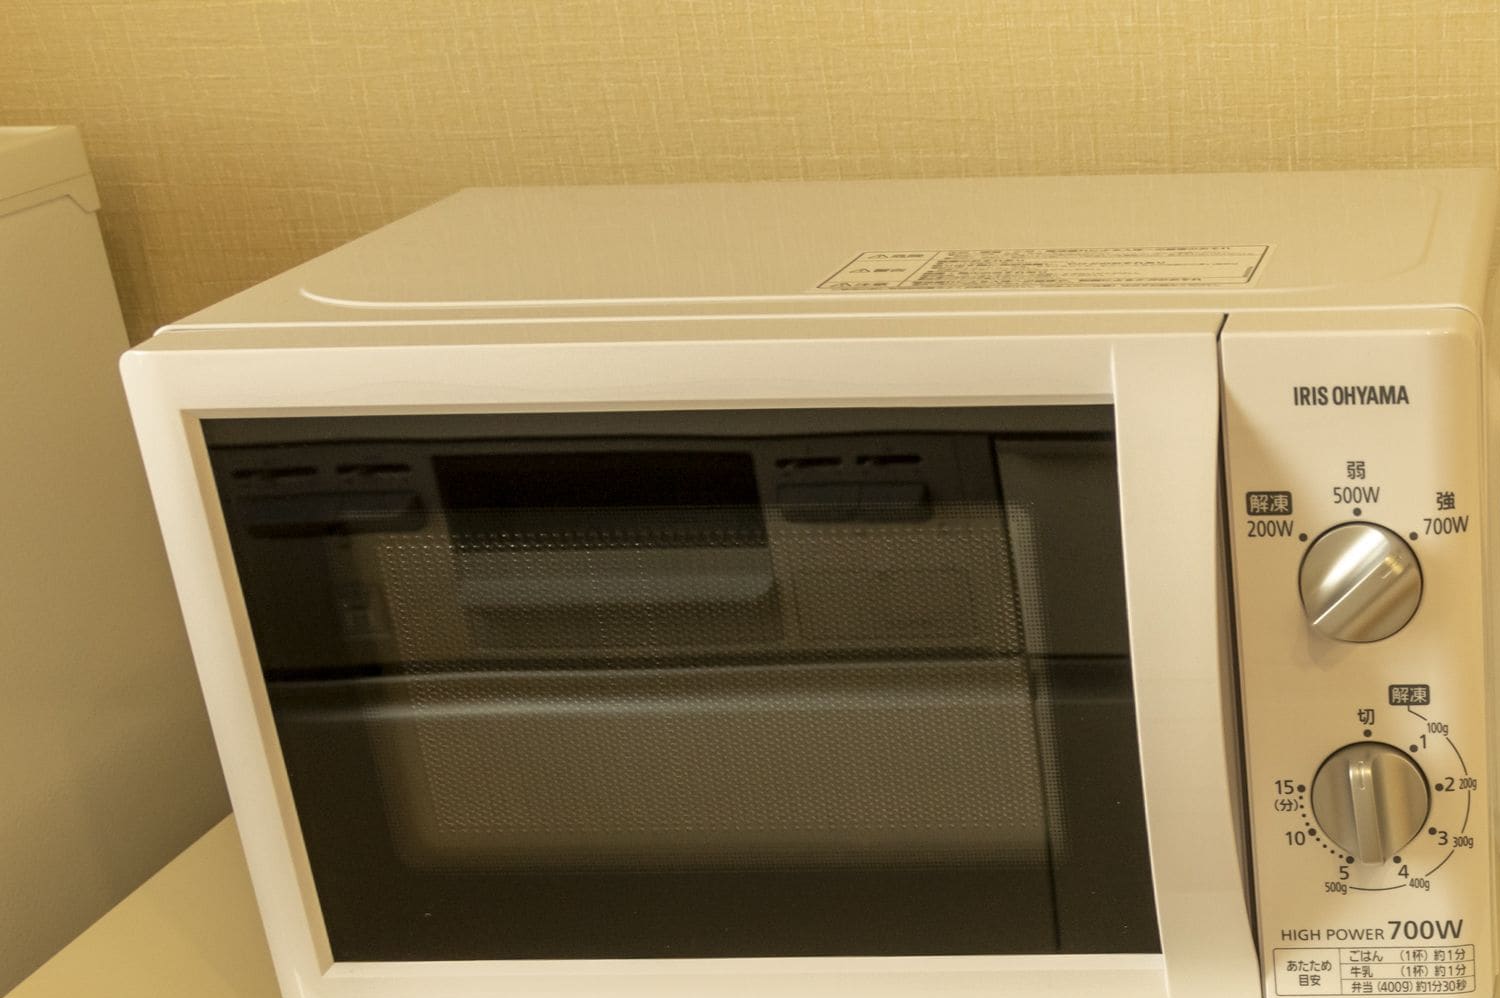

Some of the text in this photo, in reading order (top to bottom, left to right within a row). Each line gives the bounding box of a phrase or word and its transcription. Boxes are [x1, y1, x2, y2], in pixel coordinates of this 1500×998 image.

[1293, 385, 1410, 406] IRIS OHYAMA
[1346, 461, 1366, 480] 弱
[1333, 486, 1380, 504] 500W
[1436, 491, 1456, 510] 強
[1249, 494, 1289, 513] 解凍
[1247, 520, 1294, 538] 200W
[1423, 515, 1470, 535] 700W
[1391, 687, 1428, 703] 解凍
[1357, 708, 1375, 725] 切
[1427, 722, 1449, 737] 100g
[1420, 734, 1427, 749] 1
[1275, 780, 1294, 794] 15
[1445, 777, 1455, 791] 2
[1459, 778, 1477, 790] 200g
[1286, 831, 1305, 846] 10
[1438, 831, 1448, 845] 3
[1453, 836, 1474, 848] 300g
[1339, 866, 1349, 880] 5
[1398, 865, 1409, 879] 4
[1325, 882, 1347, 895] 500g
[1409, 878, 1430, 891] 400g
[1281, 919, 1463, 941] HIGH POWER 700W
[1349, 950, 1383, 962] ごはん
[1287, 960, 1332, 972] あたため
[1350, 966, 1373, 978] 牛乳
[1299, 975, 1321, 987] 目安
[1351, 982, 1373, 993] 弁当
